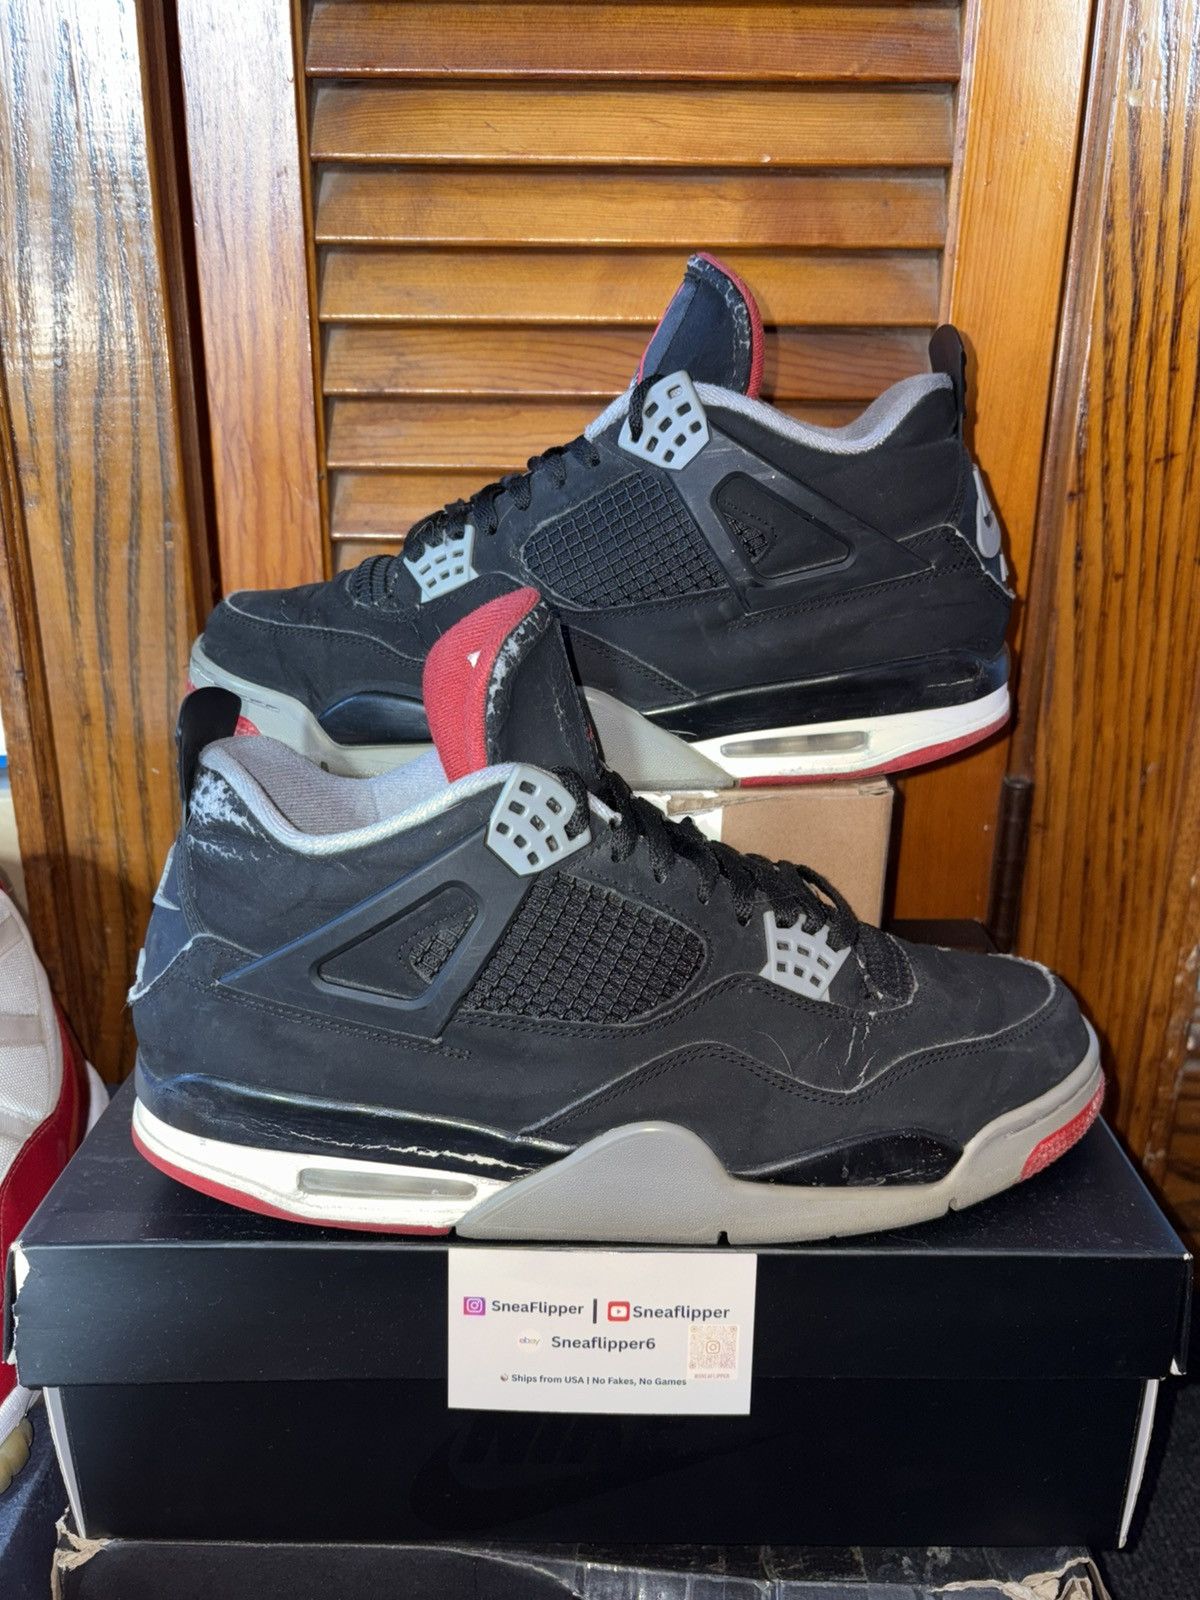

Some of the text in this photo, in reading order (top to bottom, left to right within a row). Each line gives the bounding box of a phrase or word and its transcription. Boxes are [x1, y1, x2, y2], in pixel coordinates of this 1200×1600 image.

[491, 1299, 585, 1318] SneaFlipper
[632, 1304, 731, 1322] Sneaflipper
[551, 1335, 656, 1353] Sneaflipper6
[511, 1373, 538, 1385] Ships
[539, 1374, 563, 1384] from
[563, 1375, 585, 1385] USA
[591, 1376, 606, 1385] No
[607, 1376, 637, 1387] Fakes,
[638, 1377, 653, 1386] No
[654, 1377, 688, 1386] Games
